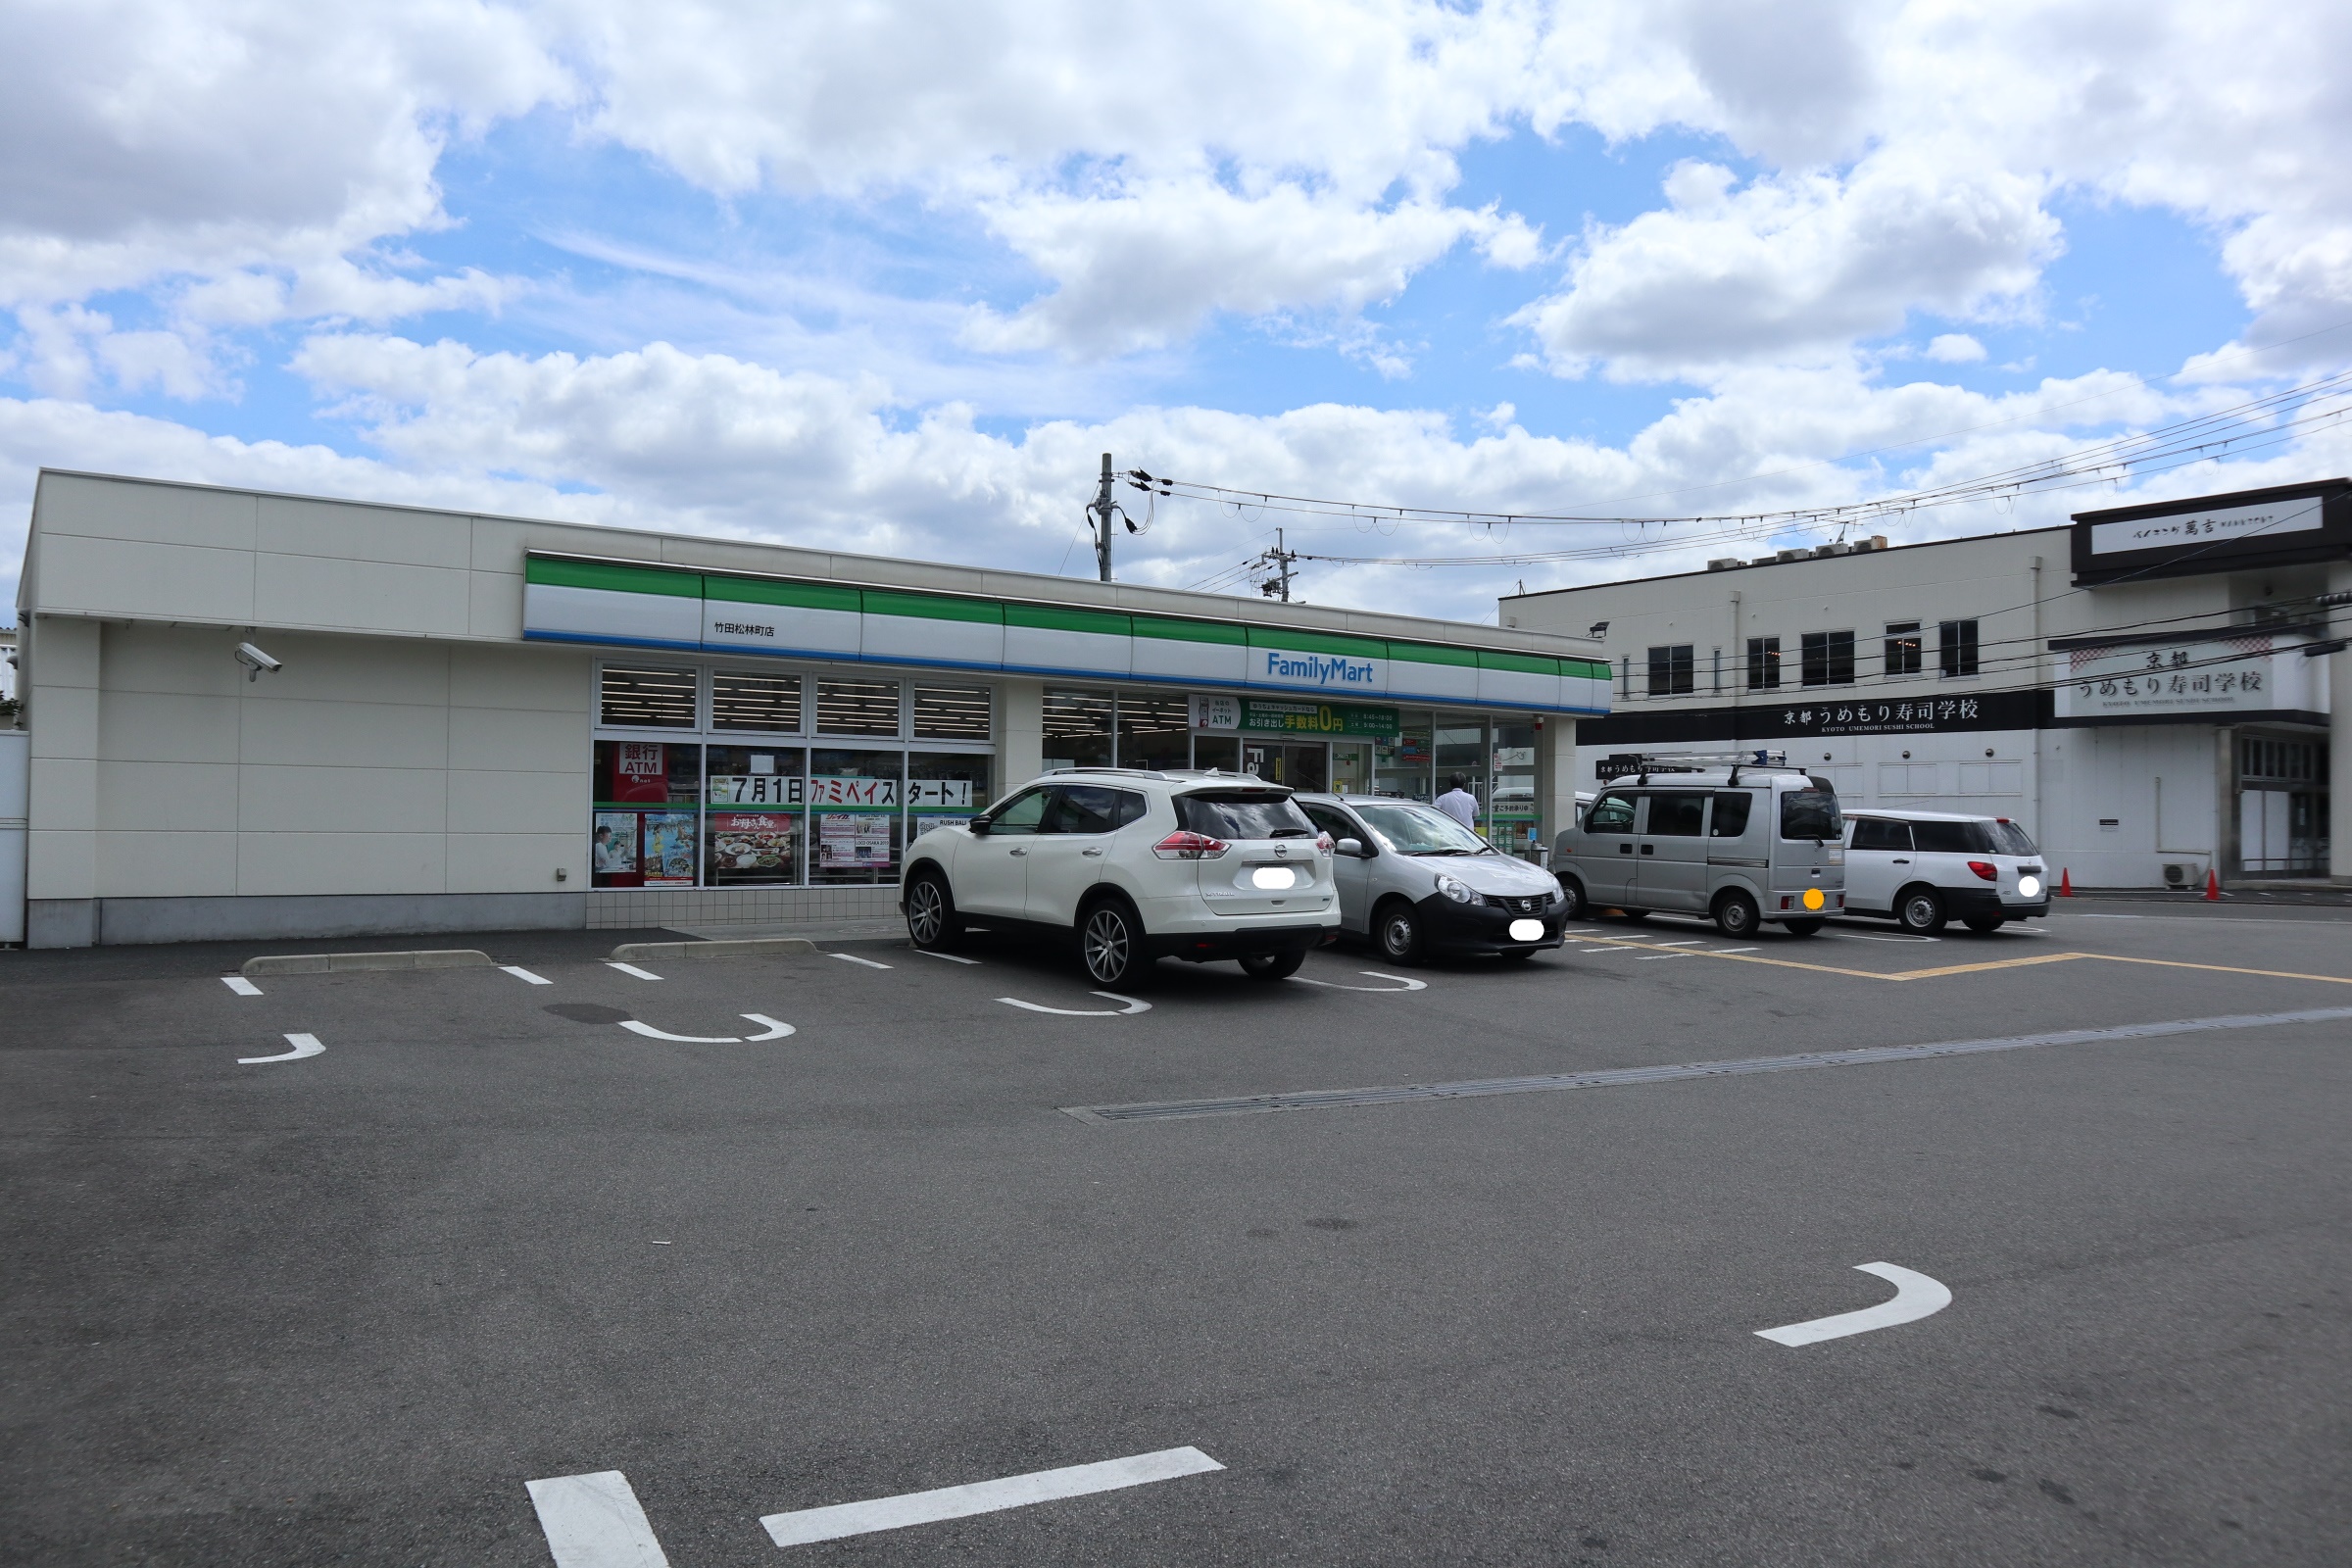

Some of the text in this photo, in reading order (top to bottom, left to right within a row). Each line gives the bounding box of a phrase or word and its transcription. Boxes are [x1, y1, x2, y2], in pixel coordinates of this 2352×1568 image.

[714, 621, 774, 637] 竹田松林町店
[1267, 652, 1373, 684] FamilyMart
[2079, 671, 2262, 697] うめもり寿司学校
[1212, 714, 1231, 724] ATM
[1784, 699, 1979, 725] 京都 うめもり寿司学校
[1250, 718, 1284, 727] お引き出し
[624, 745, 658, 760] 銀行
[624, 761, 657, 773] ATM
[730, 815, 774, 829] お母さん食堂
